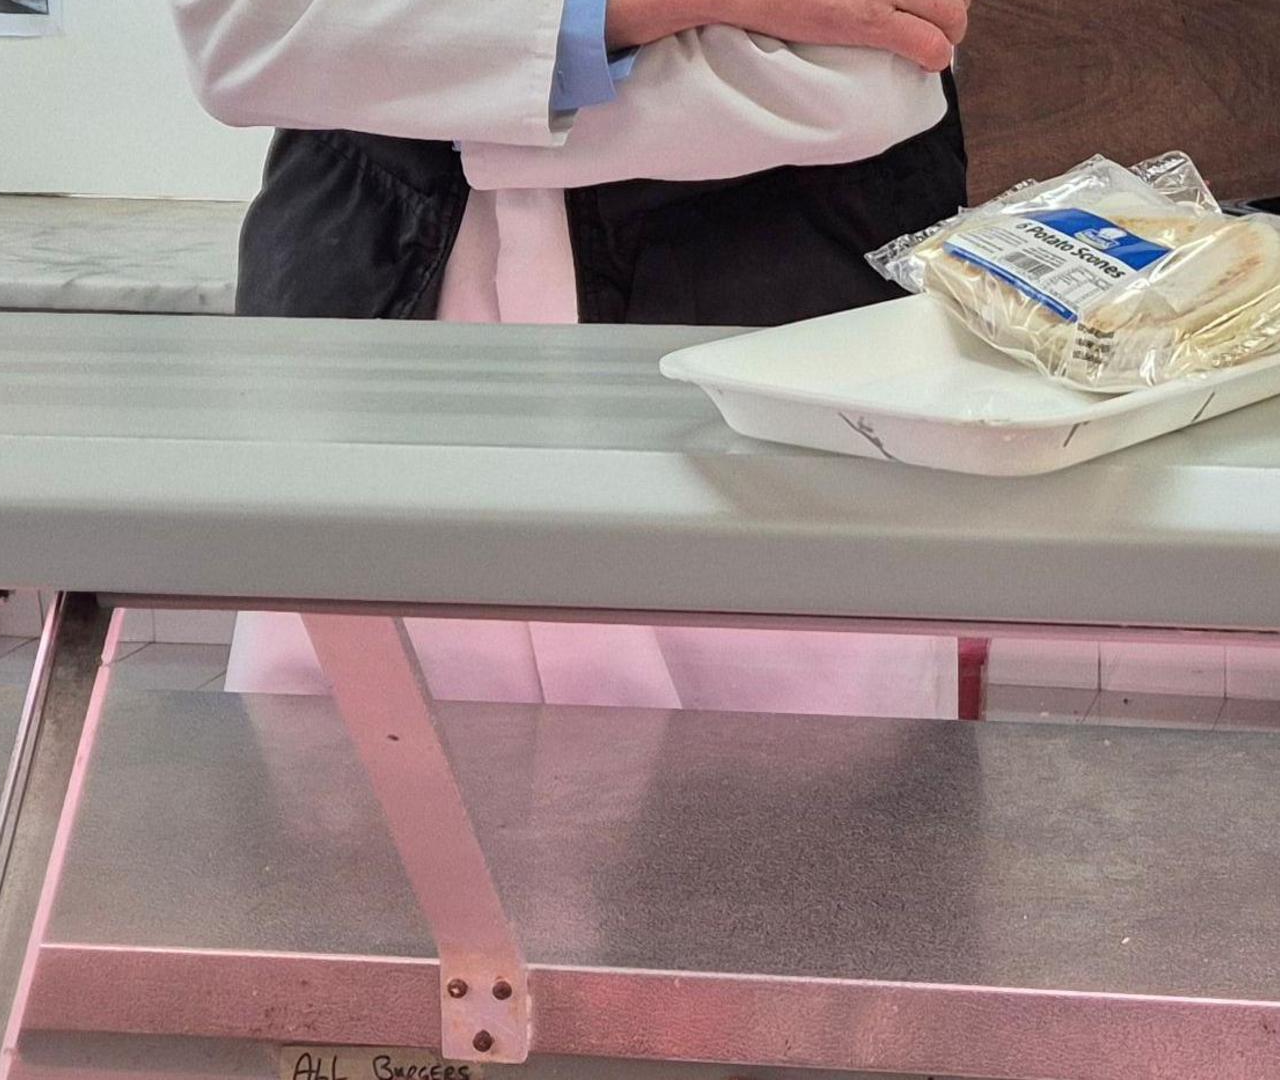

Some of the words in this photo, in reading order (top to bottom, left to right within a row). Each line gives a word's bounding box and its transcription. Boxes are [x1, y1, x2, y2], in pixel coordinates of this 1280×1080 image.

[1026, 226, 1074, 252] Potato
[1071, 246, 1126, 278] Scones
[292, 1053, 348, 1080] ALL
